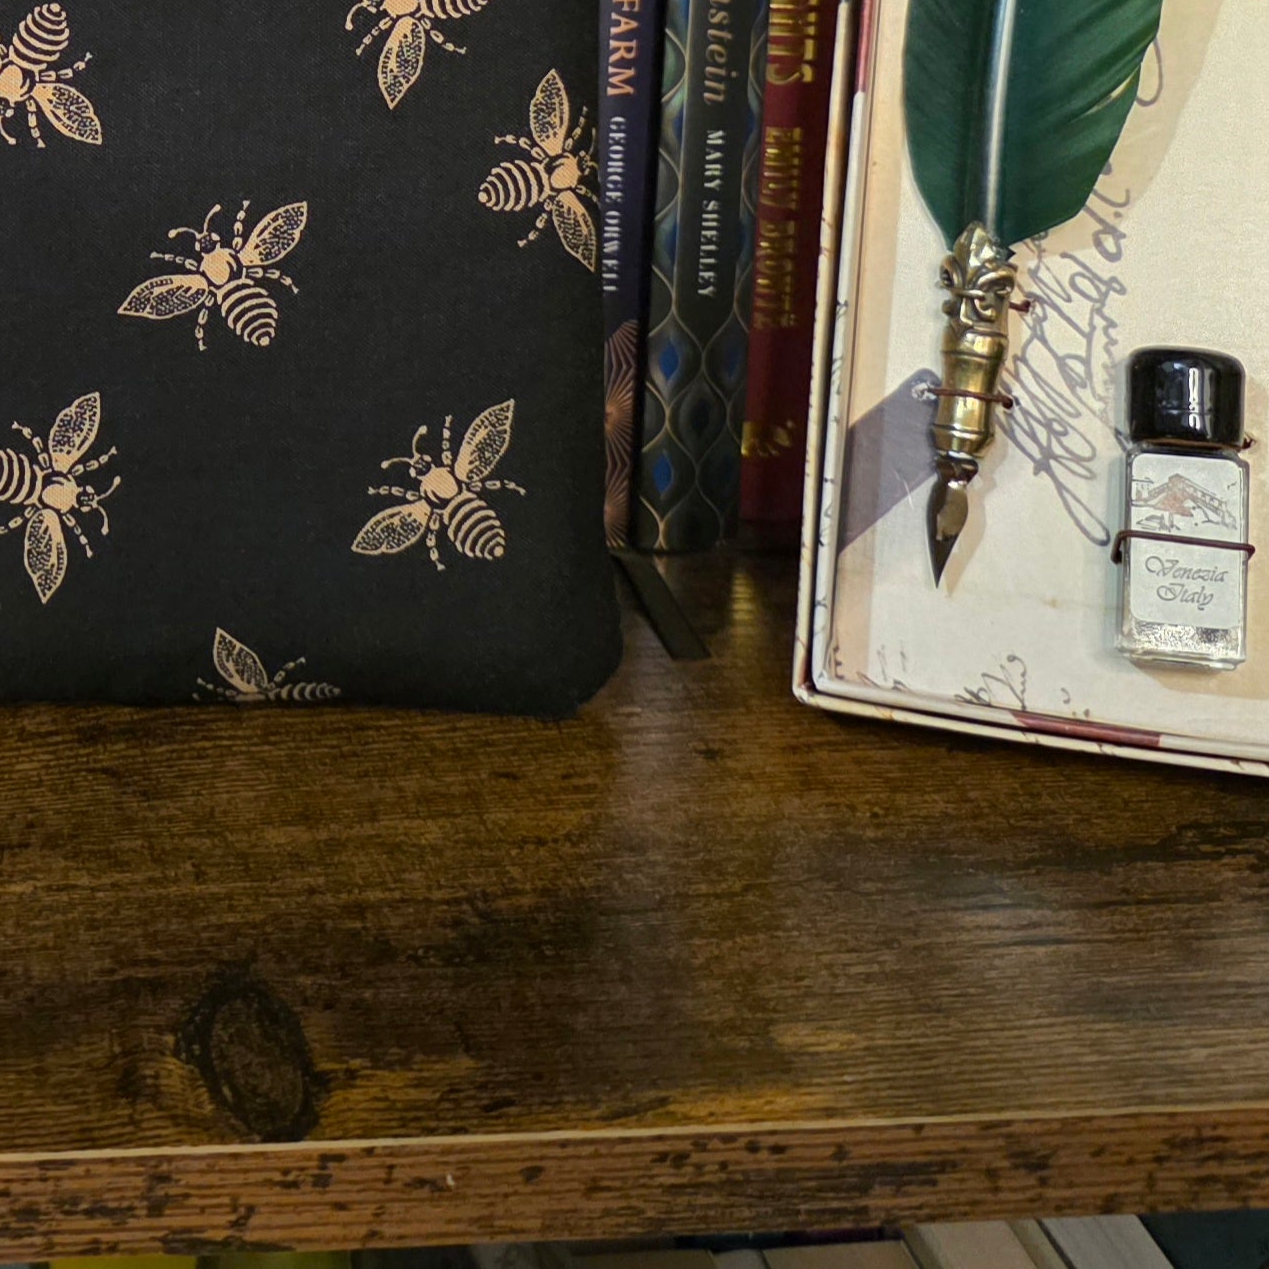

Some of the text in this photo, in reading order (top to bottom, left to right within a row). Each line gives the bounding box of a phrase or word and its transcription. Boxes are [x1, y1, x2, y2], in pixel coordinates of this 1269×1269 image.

[602, 117, 627, 291] GEORGE ORWELL
[761, 127, 802, 213] EMILY
[697, 131, 724, 298] MARY SHELLEY
[1145, 555, 1228, 582] Venezia
[1156, 582, 1214, 611] Italy
